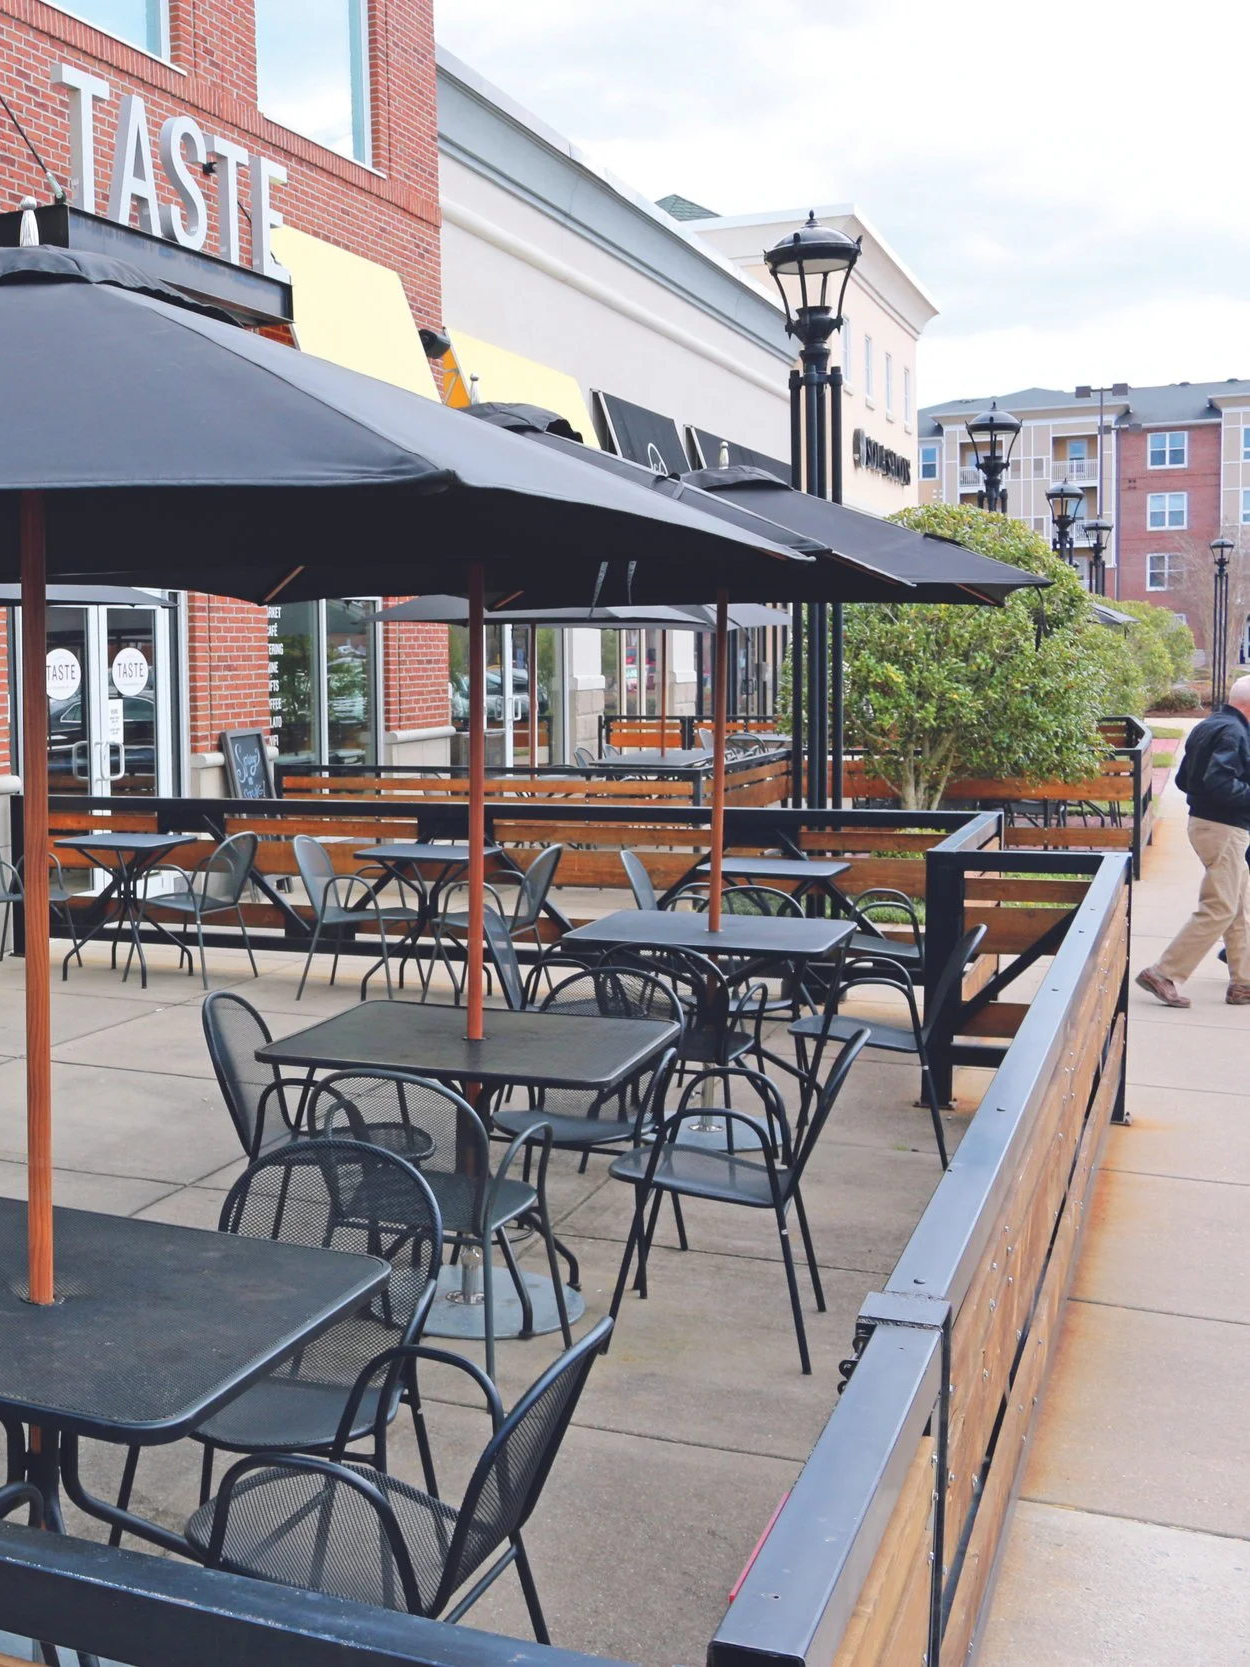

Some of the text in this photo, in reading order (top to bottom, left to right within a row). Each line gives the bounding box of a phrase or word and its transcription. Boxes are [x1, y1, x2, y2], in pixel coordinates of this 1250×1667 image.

[50, 63, 292, 286] TASTE
[268, 643, 284, 656] ERING
[46, 664, 76, 680] TASTE
[117, 662, 144, 678] TASTE
[268, 662, 278, 674] INE
[270, 716, 282, 728] LATO
